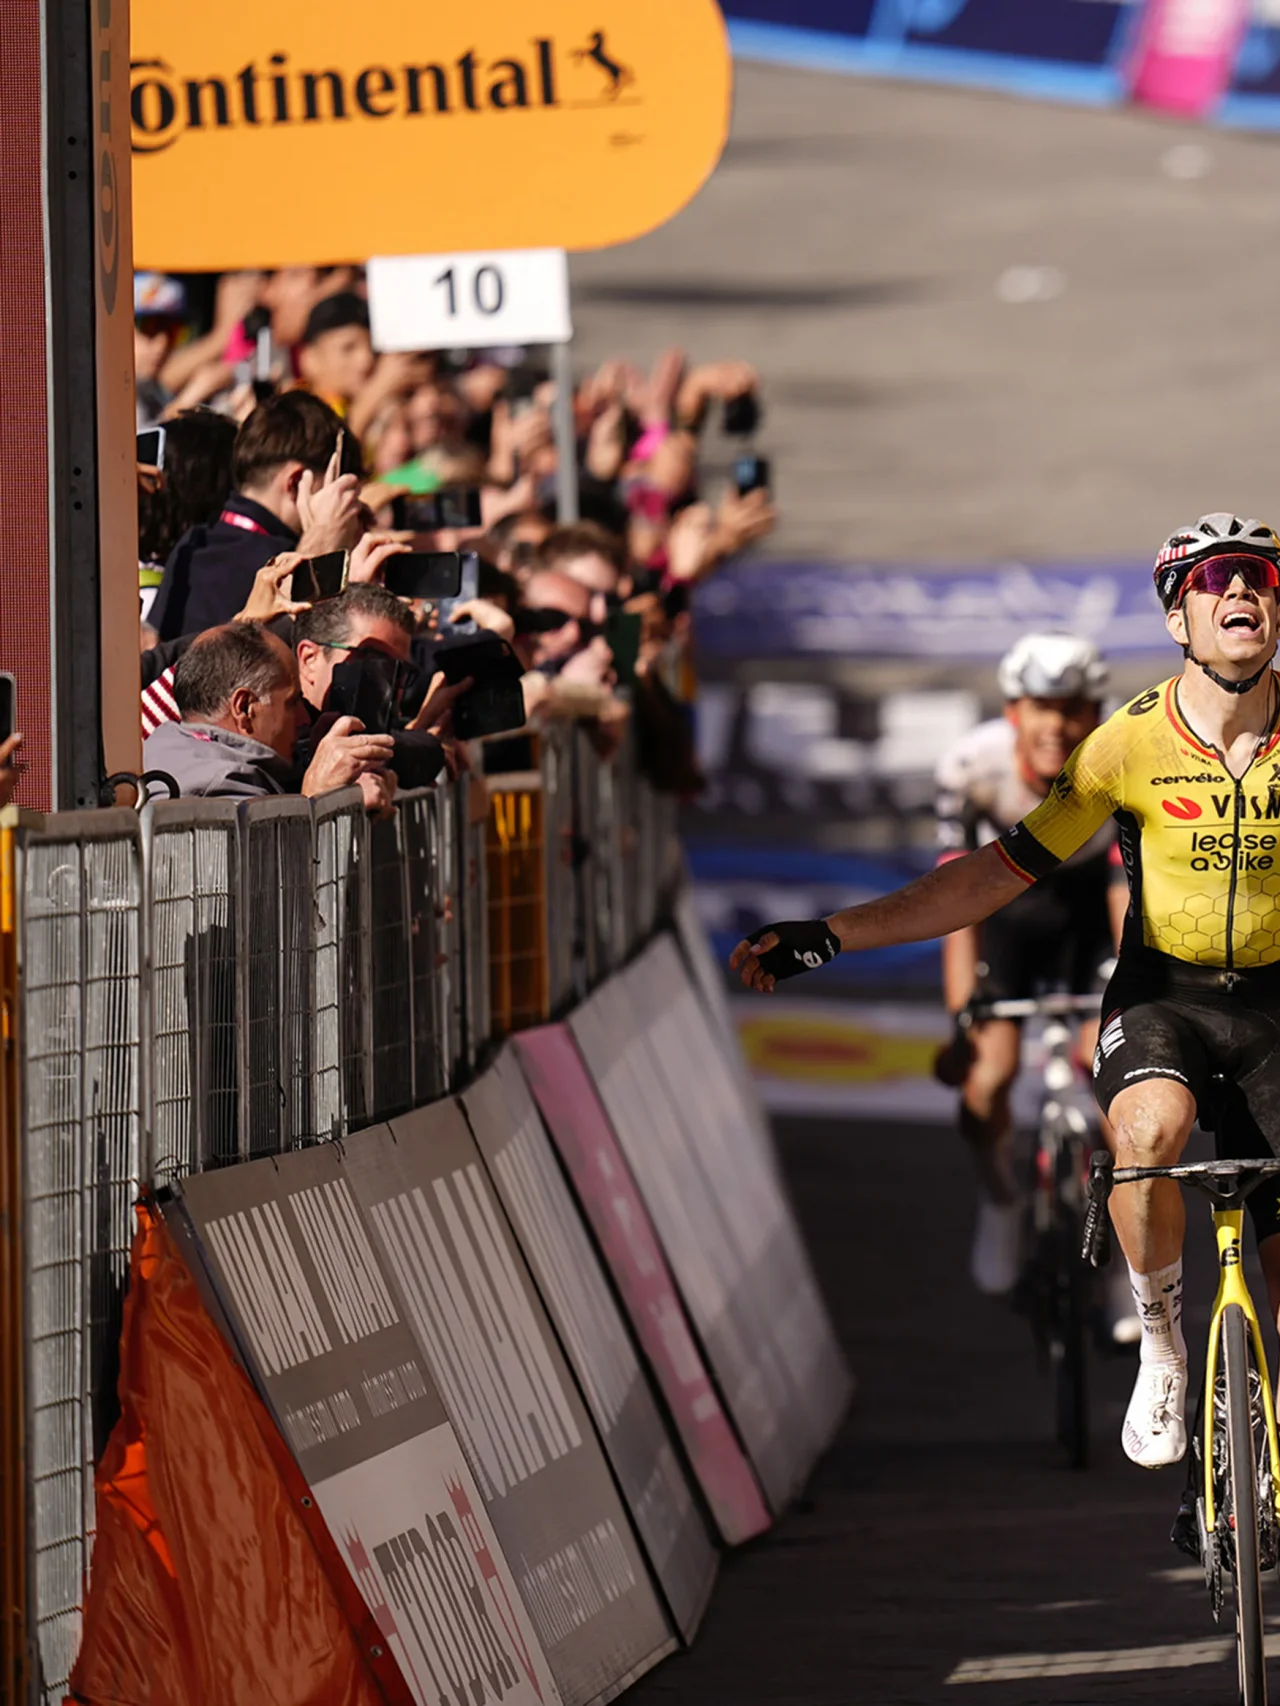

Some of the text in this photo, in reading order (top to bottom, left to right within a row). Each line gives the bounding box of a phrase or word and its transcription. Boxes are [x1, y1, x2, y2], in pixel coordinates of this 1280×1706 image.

[434, 264, 506, 316] 10
[1150, 772, 1226, 786] cervélo
[1191, 832, 1277, 852] lease
[373, 1511, 521, 1706] TUDOR
